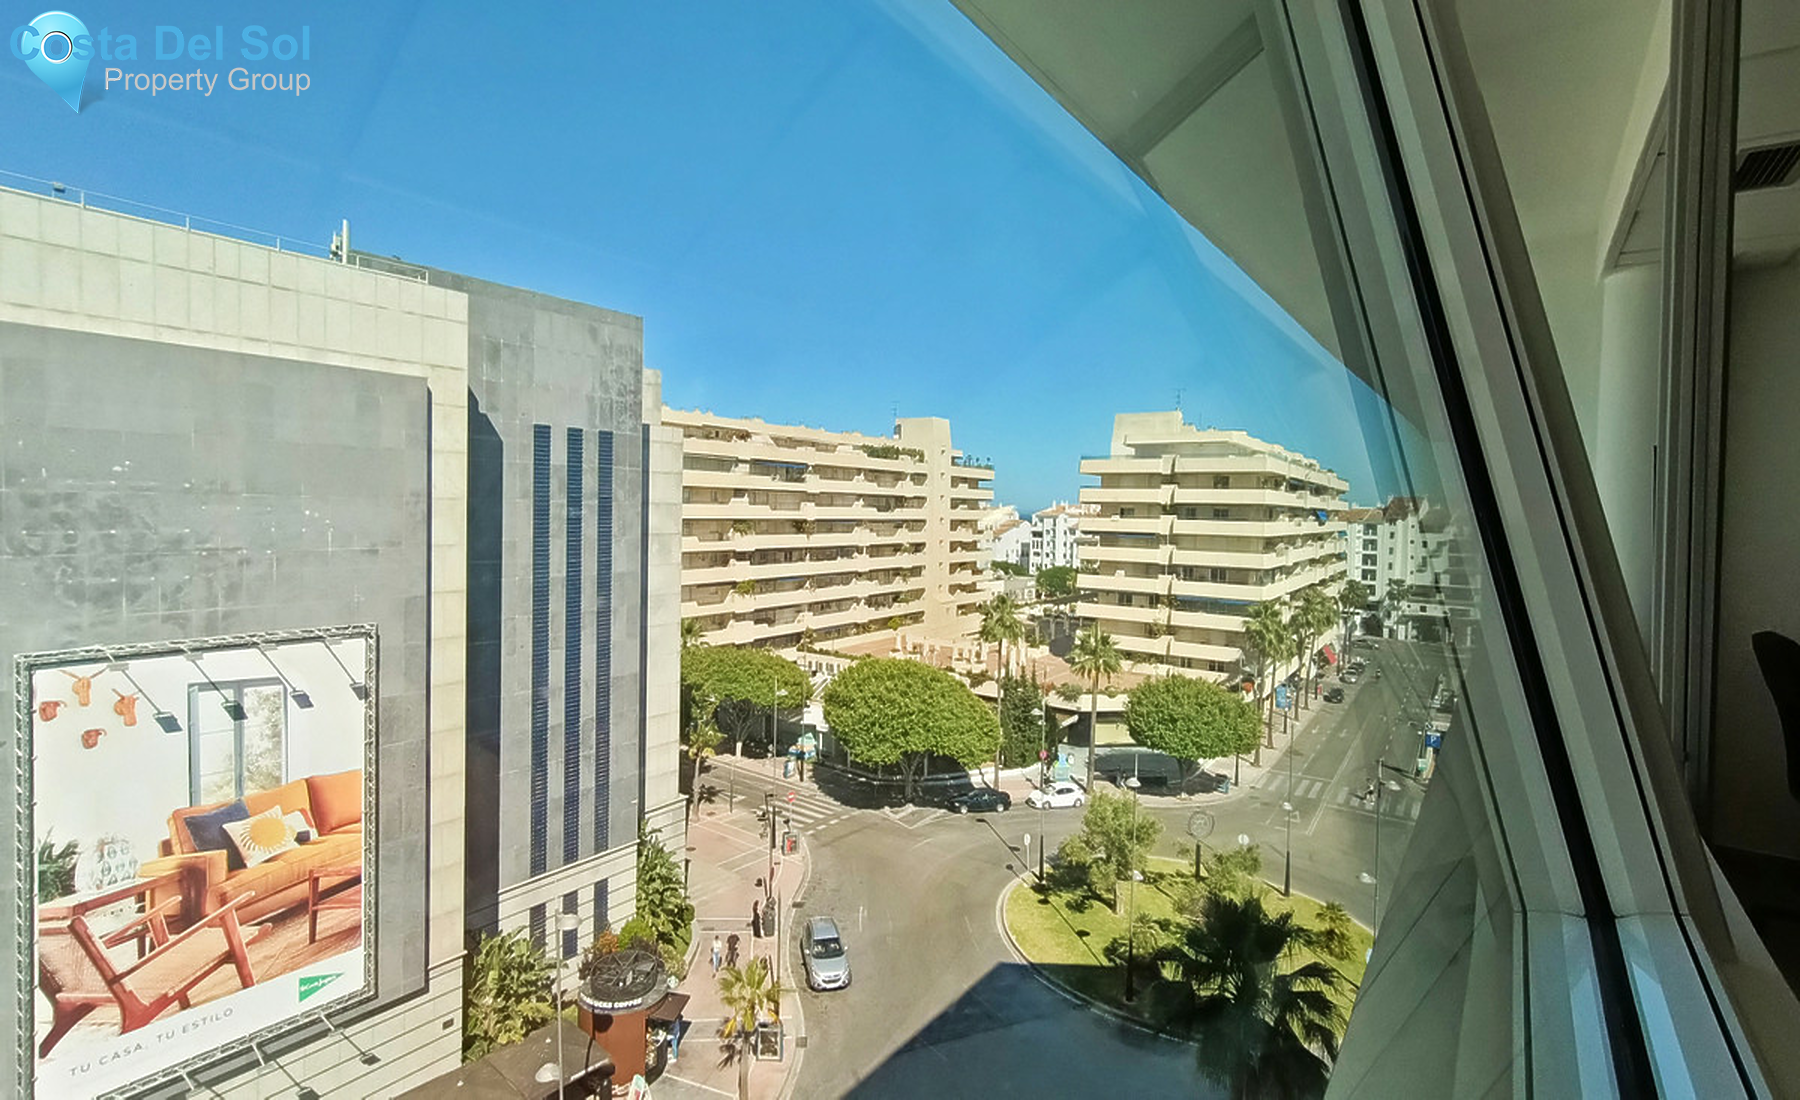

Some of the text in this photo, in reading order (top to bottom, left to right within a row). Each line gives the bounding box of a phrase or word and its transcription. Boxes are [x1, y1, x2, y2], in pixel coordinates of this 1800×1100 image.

[69, 1063, 91, 1077] TU
[157, 1031, 176, 1043] TU
[182, 1008, 233, 1034] ESTILO
